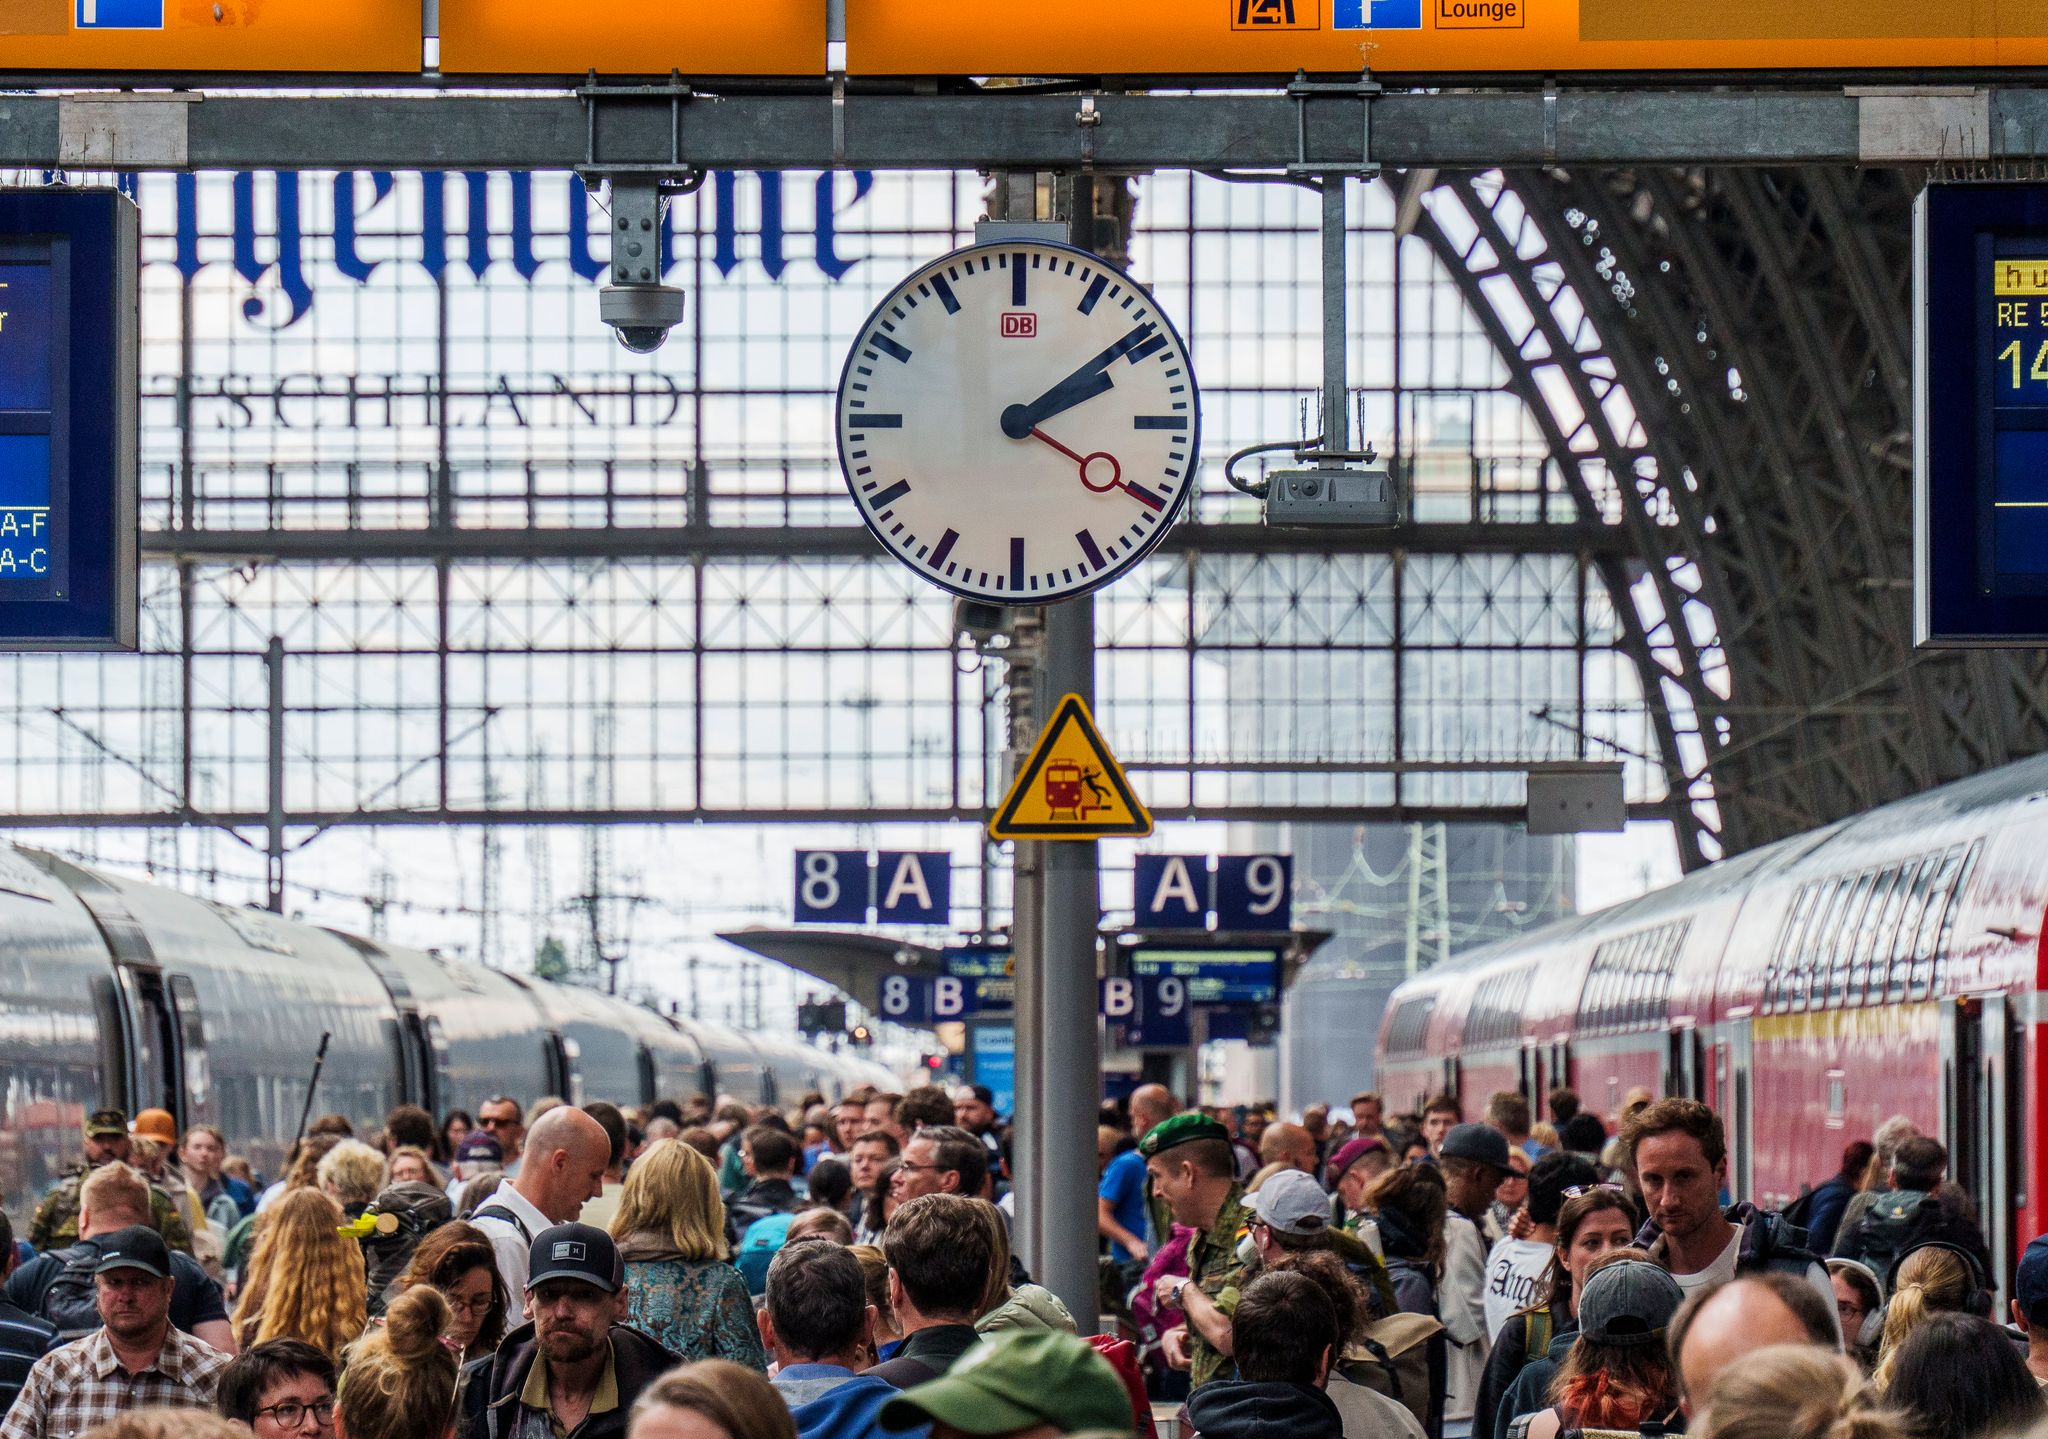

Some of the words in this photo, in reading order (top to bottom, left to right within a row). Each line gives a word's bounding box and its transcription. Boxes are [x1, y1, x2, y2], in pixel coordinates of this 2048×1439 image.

[1441, 0, 1517, 21] Lounge
[1005, 316, 1033, 334] DB
[1998, 302, 2029, 327] RE
[1, 512, 46, 537] A-F
[0, 548, 46, 573] A-C
[802, 851, 840, 910] 8
[884, 852, 933, 910] A
[1151, 856, 1199, 913] A
[1245, 856, 1284, 916] 9
[883, 975, 910, 1015] 8
[934, 976, 964, 1016] B
[1104, 977, 1134, 1017] B
[1157, 977, 1185, 1017] 9
